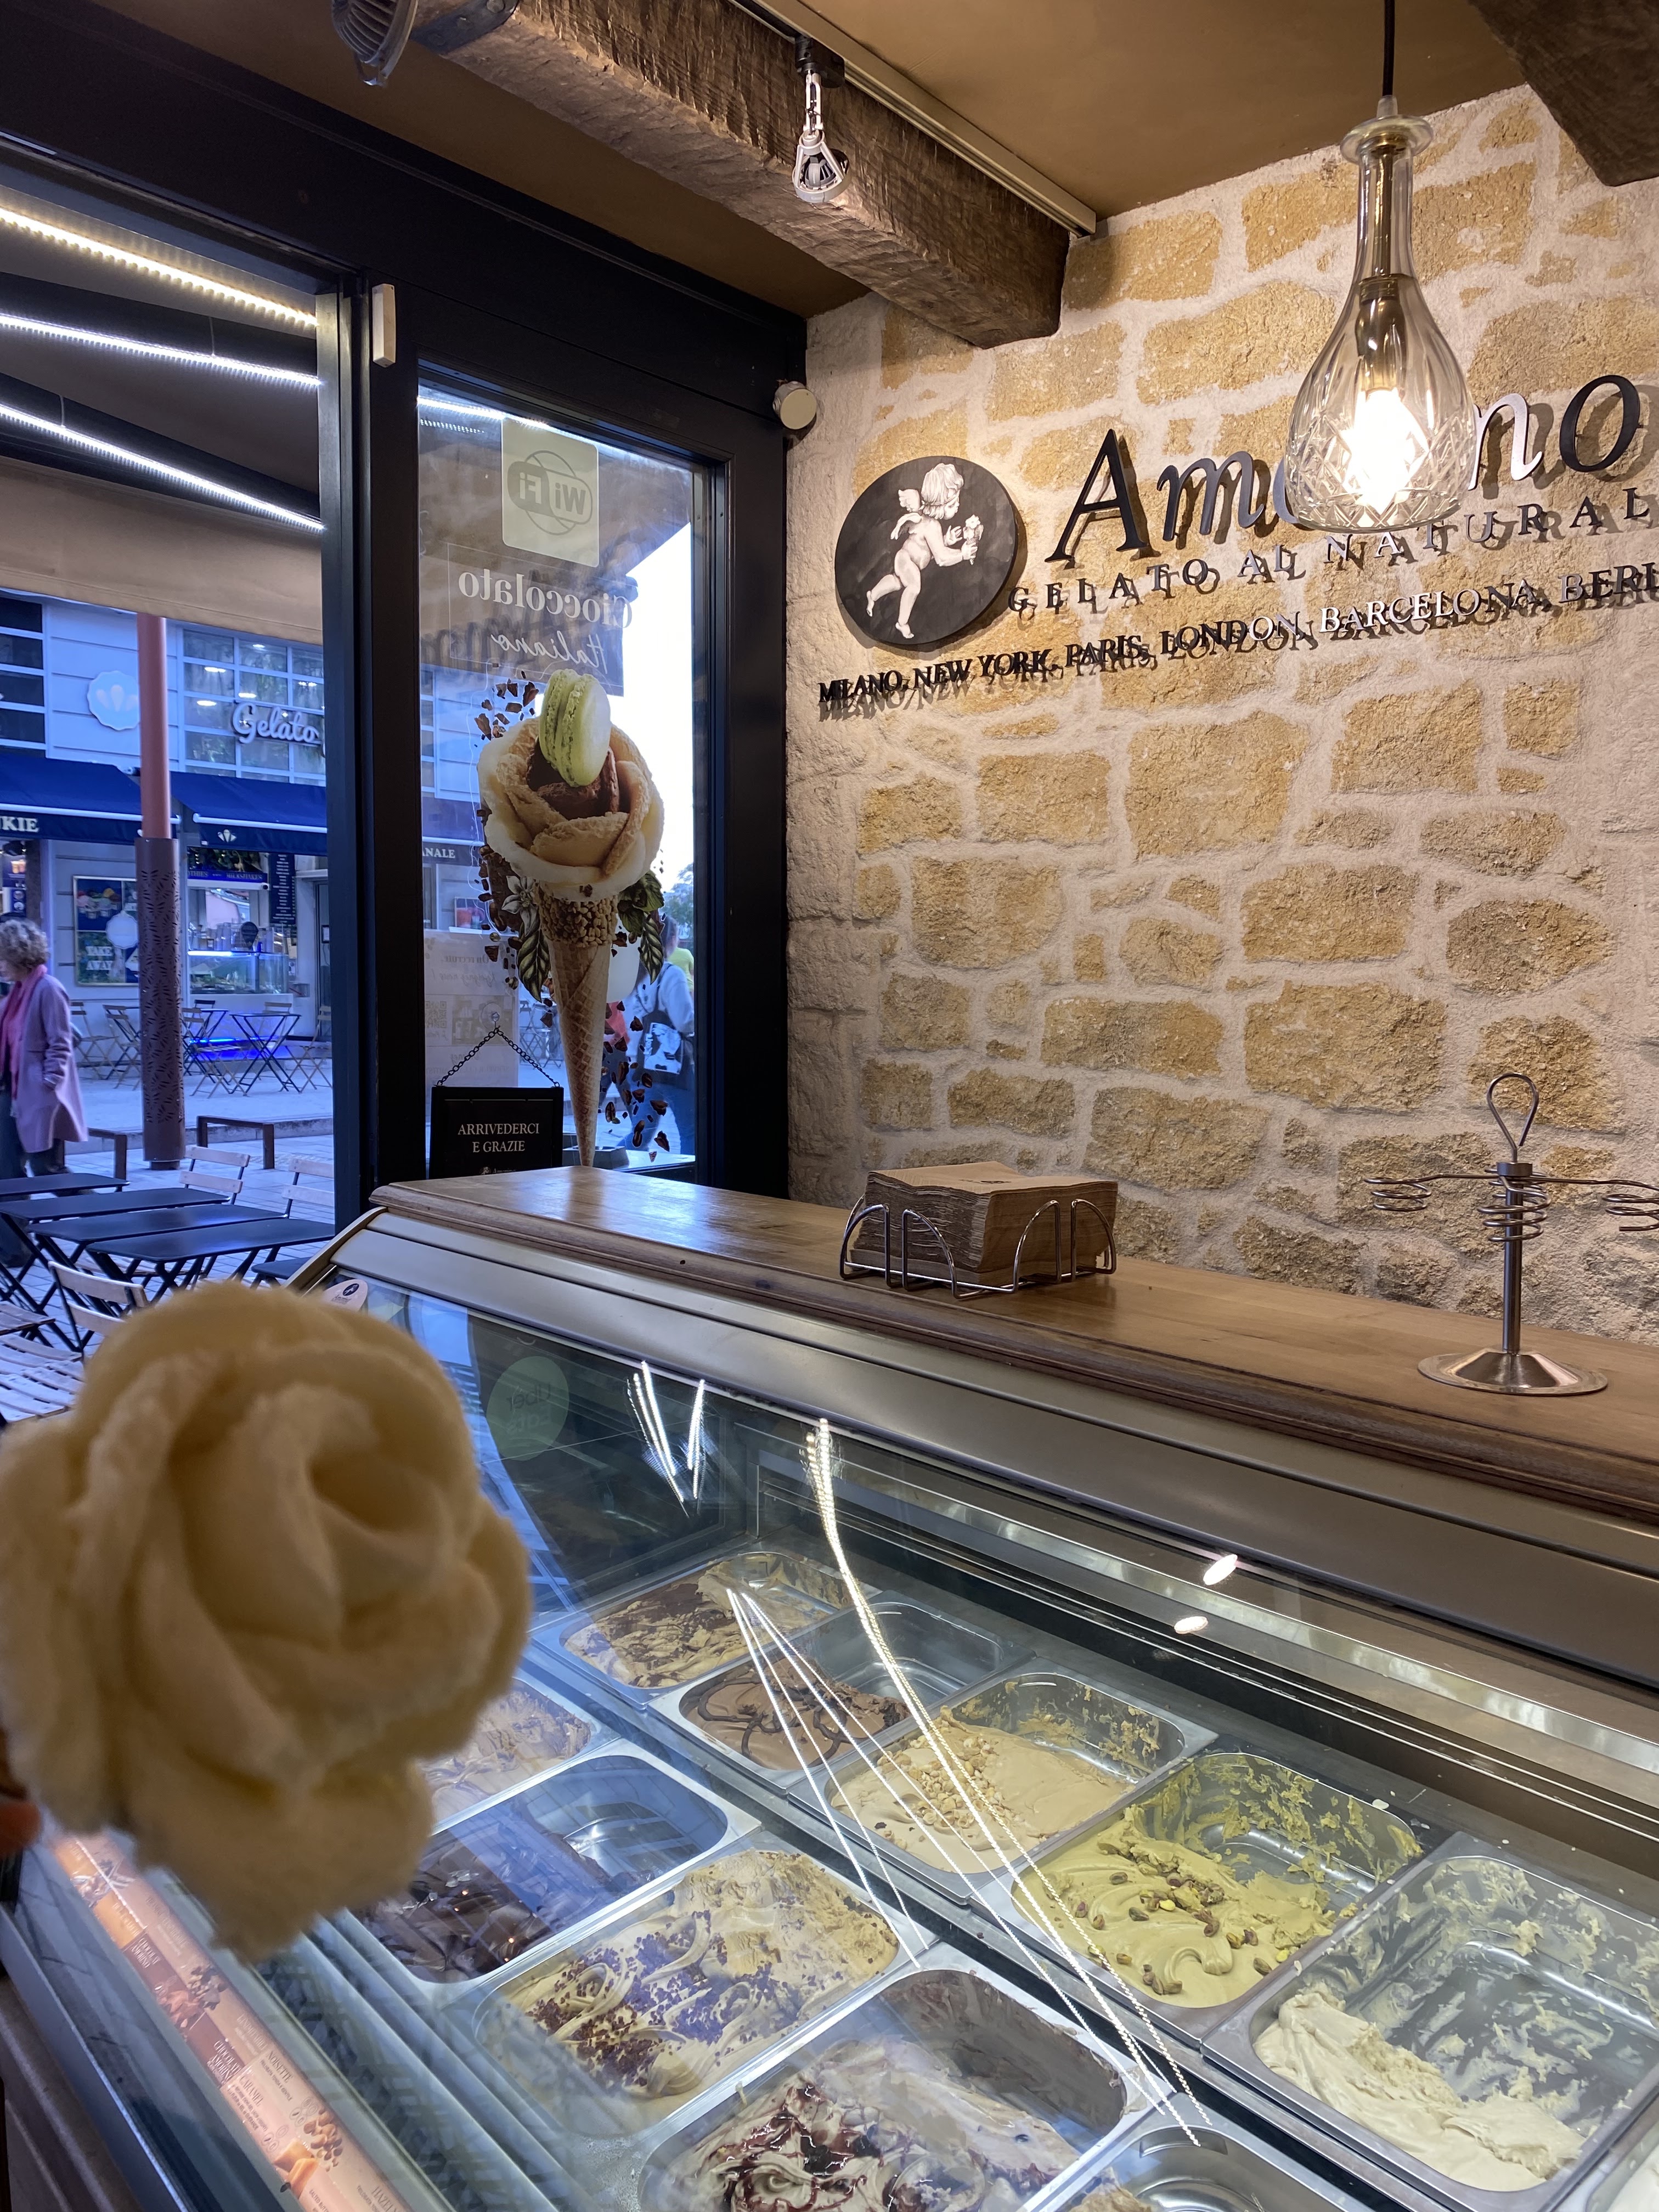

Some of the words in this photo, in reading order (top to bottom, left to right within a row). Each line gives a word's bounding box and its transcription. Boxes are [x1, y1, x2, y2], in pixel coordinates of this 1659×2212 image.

[1045, 374, 1641, 562] Amno
[1008, 559, 1207, 612] GELATO
[1238, 544, 1296, 577] AL
[913, 659, 973, 689] NEW
[233, 702, 322, 743] Gelato
[0, 816, 40, 833] KIE
[458, 1123, 540, 1135] ARRIVEDERCI
[472, 1141, 480, 1153] E
[483, 1141, 525, 1153] GRAZIE
[138, 1937, 161, 1965] CHOCOLAT
[267, 2050, 293, 2084] NOISETTE
[239, 2075, 264, 2107] CARAMEL
